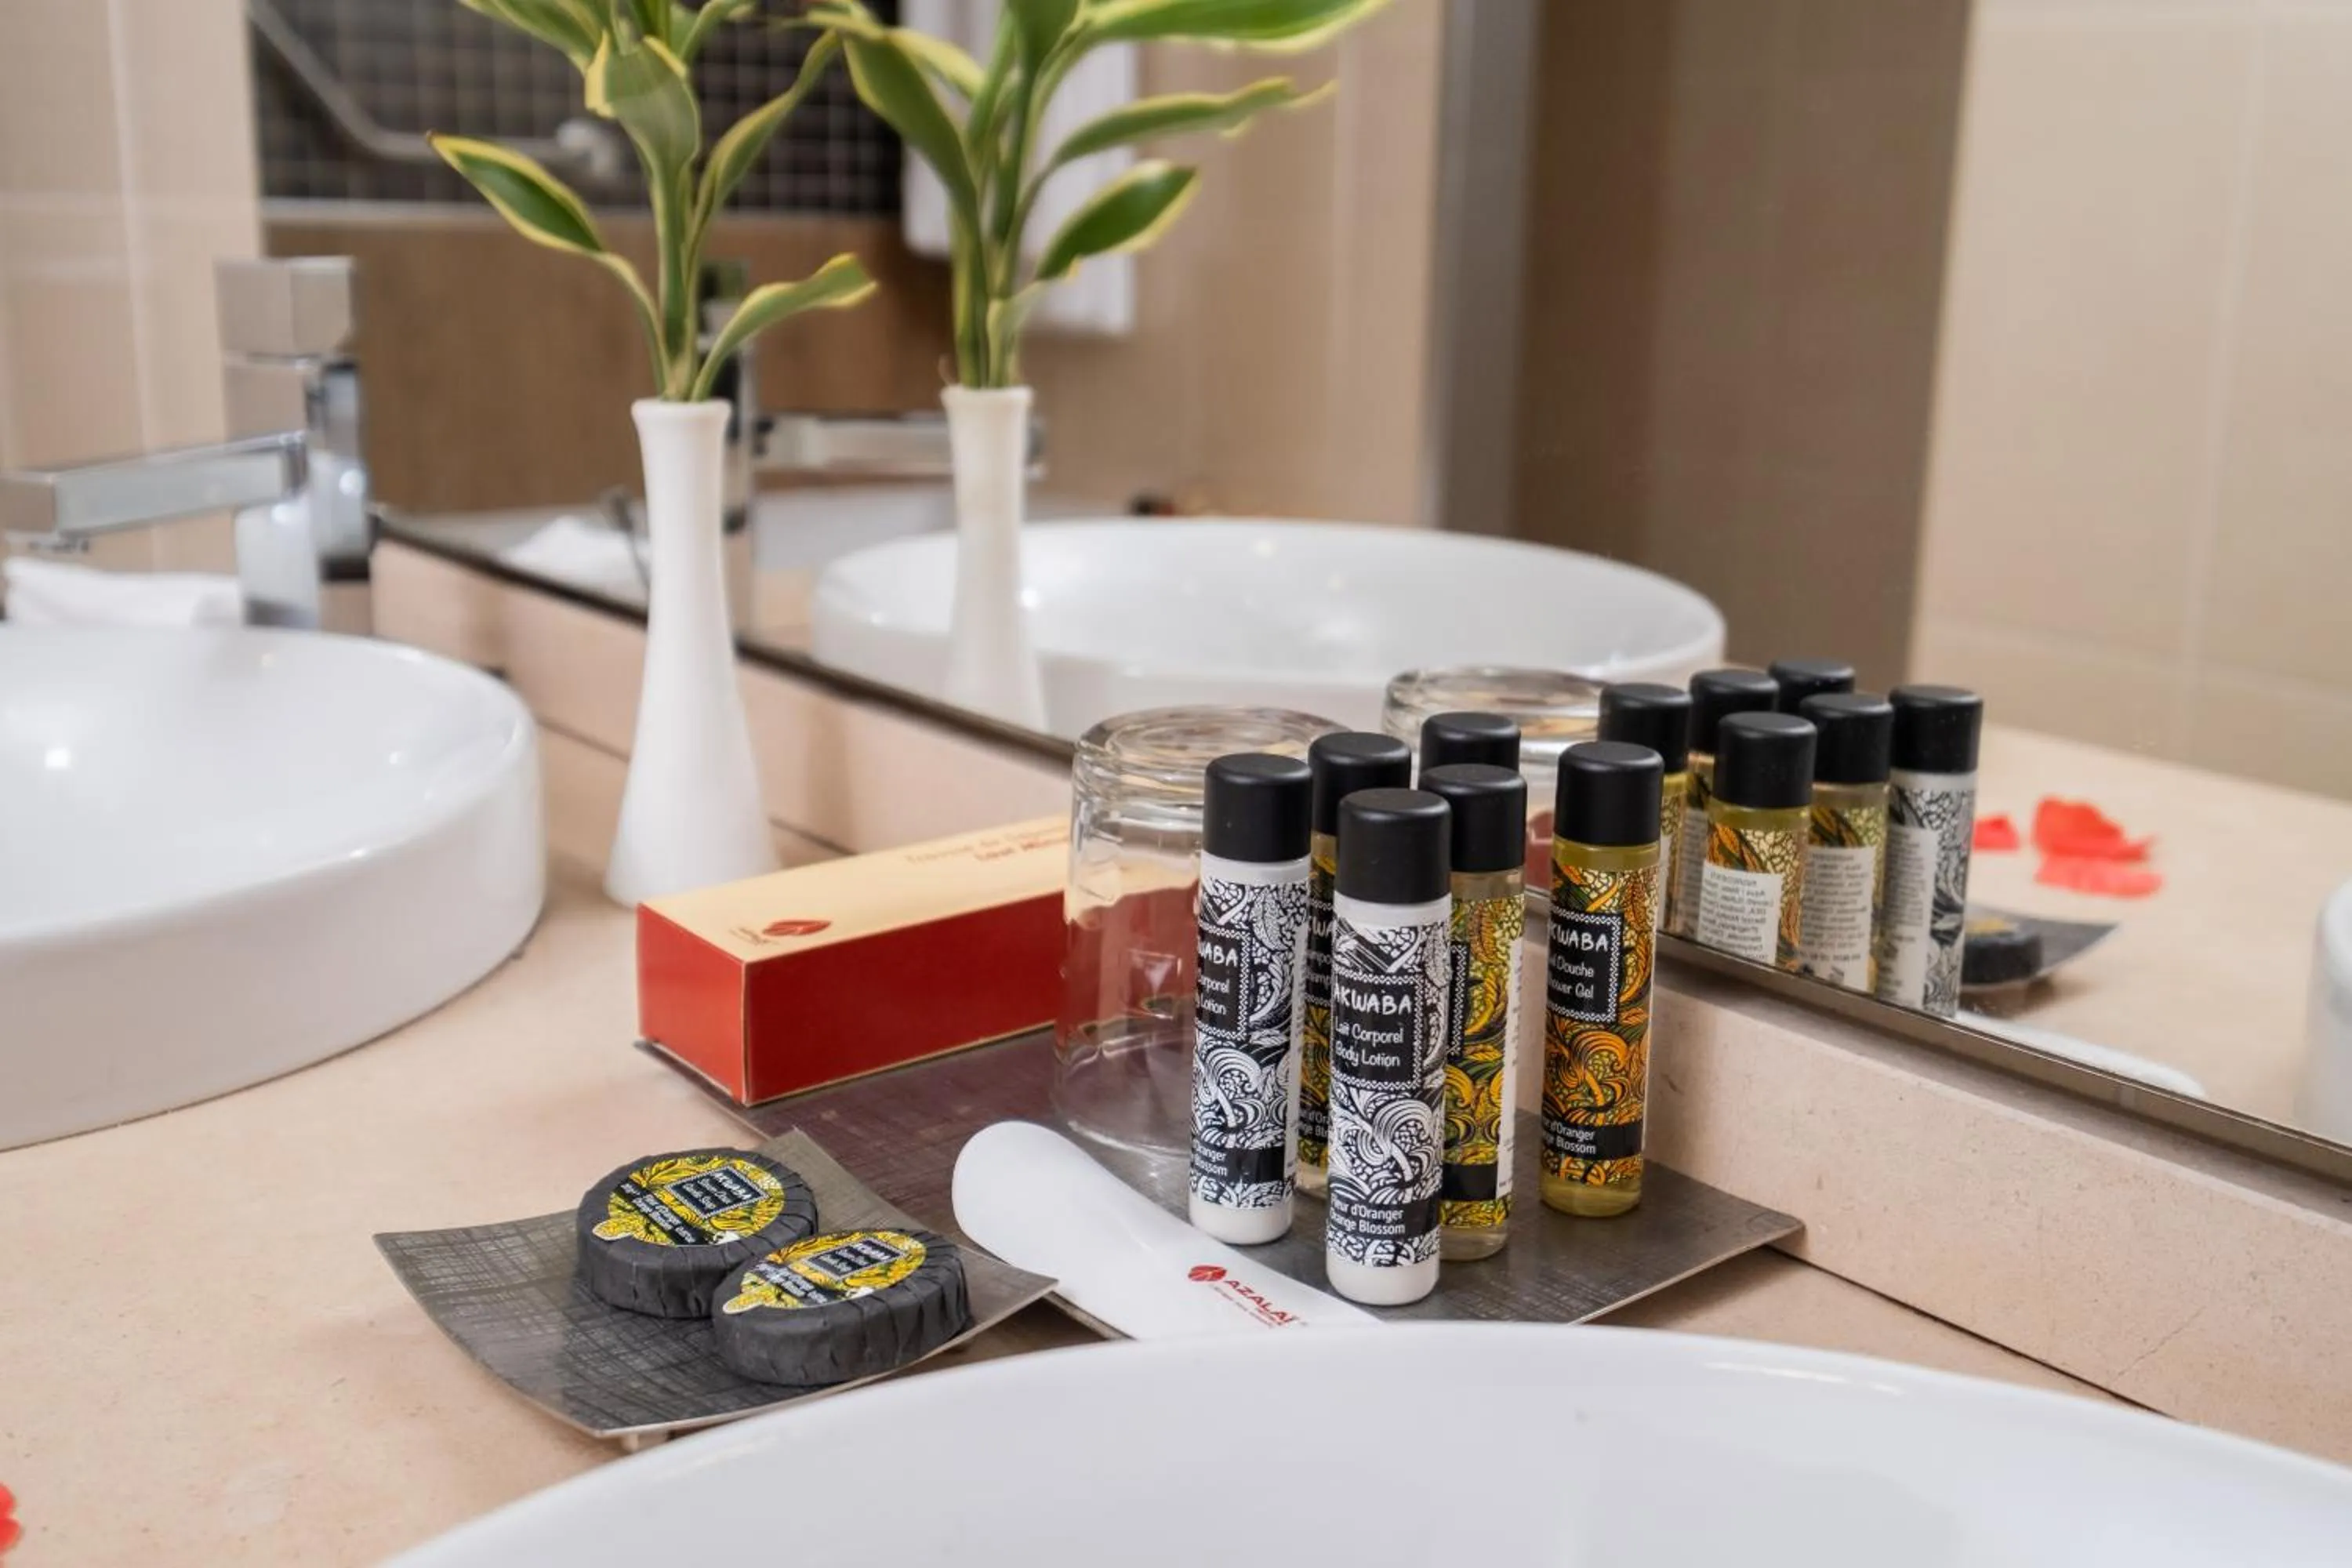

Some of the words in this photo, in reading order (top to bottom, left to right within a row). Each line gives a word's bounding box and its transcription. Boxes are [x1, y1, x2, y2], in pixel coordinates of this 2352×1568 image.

[1549, 920, 1608, 953] KWABA
[1556, 955, 1594, 978] Douche
[1333, 982, 1412, 1015] AKWABA
[1575, 982, 1594, 999] Gel
[1352, 1023, 1404, 1047] Corporel
[1335, 1040, 1359, 1067] Body
[1361, 1049, 1400, 1067] Lotion
[1556, 1134, 1597, 1155] Blossom
[1350, 1203, 1405, 1224] d'Oranger
[1359, 1219, 1406, 1236] Blossom
